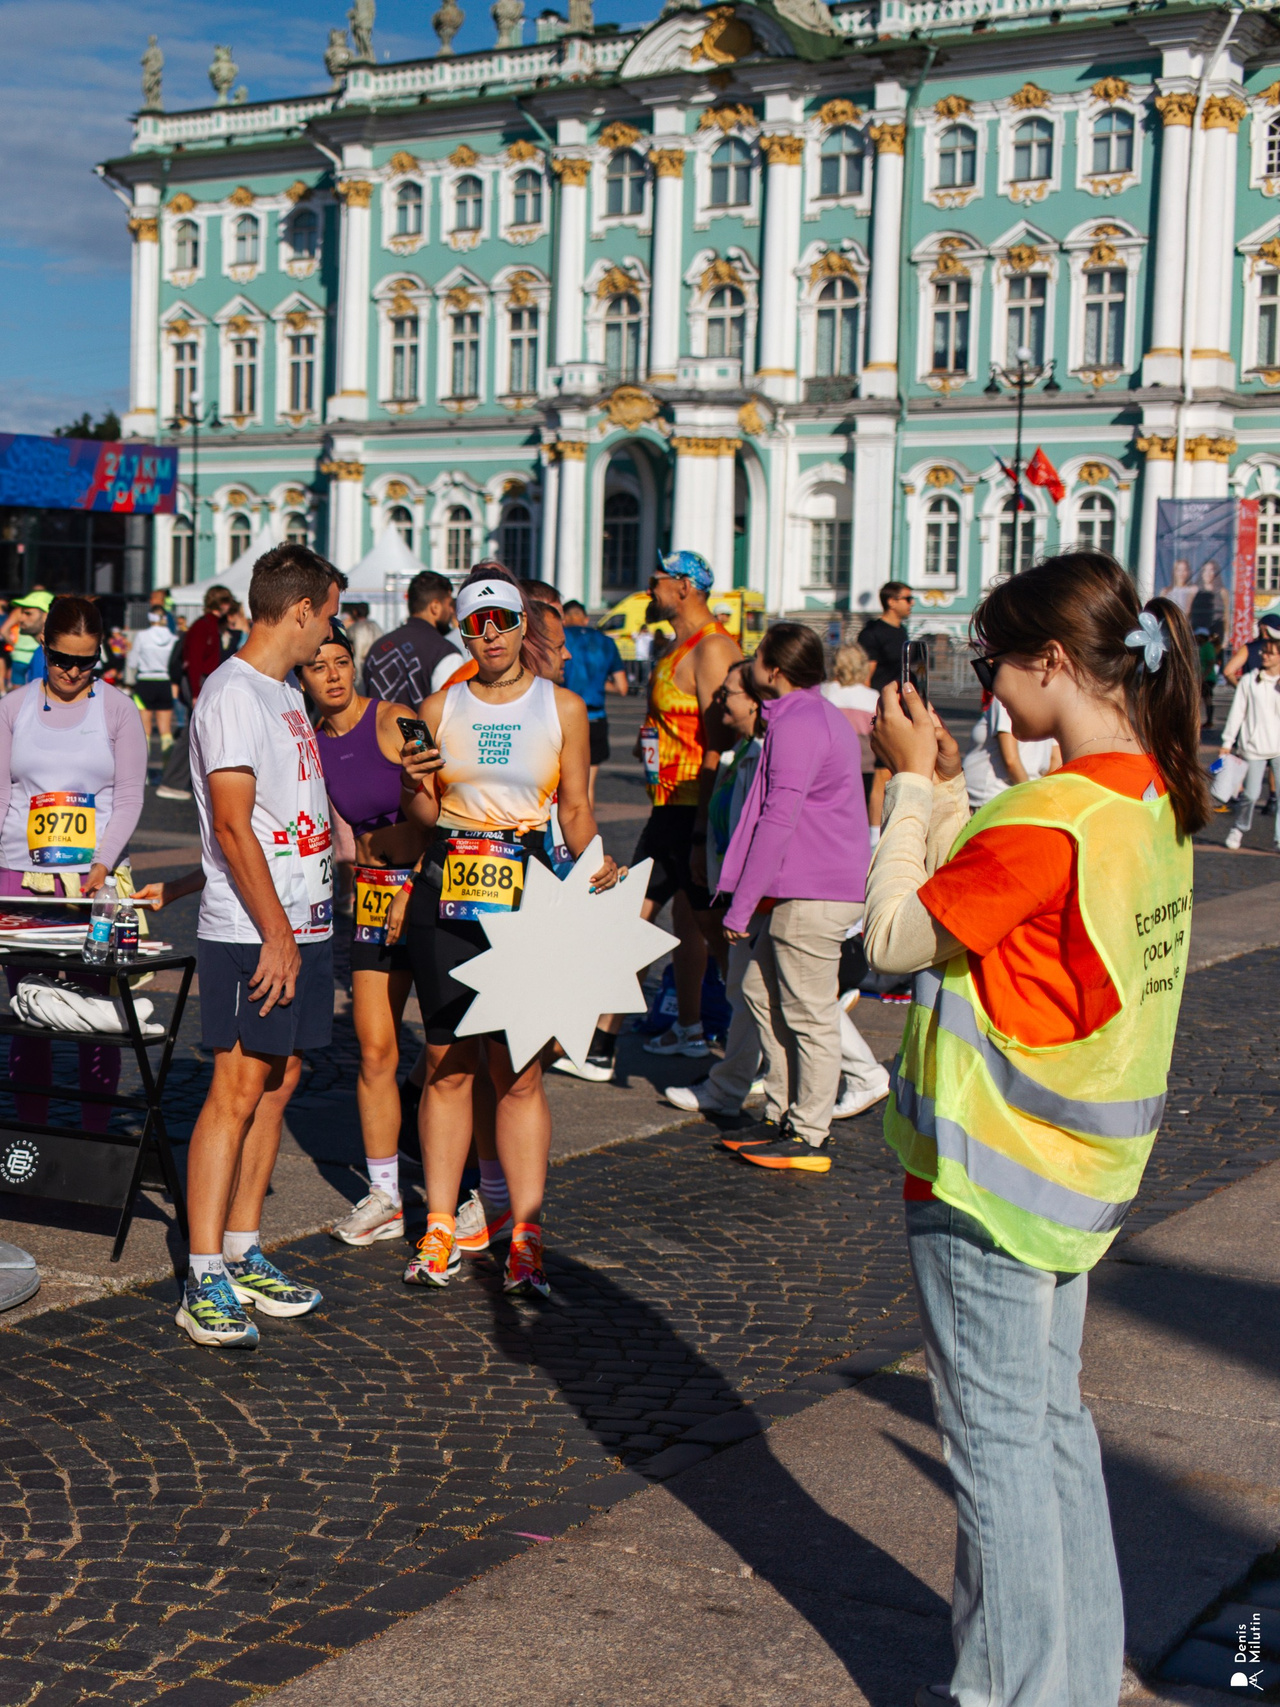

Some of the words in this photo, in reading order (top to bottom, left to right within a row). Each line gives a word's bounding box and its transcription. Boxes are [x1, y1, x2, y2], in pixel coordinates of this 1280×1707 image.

[104, 453, 139, 479] 21,1
[142, 455, 170, 479] КМ
[472, 723, 521, 732] Golden
[480, 732, 512, 741] Ring
[478, 740, 513, 749] Ultra
[478, 748, 510, 757] Trail
[477, 756, 509, 765] 100
[78, 796, 87, 804] КМ
[34, 812, 87, 835] 3970
[490, 844, 502, 853] 21,1
[384, 874, 396, 882] 21,1
[452, 861, 513, 890] 3688
[461, 888, 499, 899] ВАЛЕРИЯ
[362, 889, 395, 914] 472
